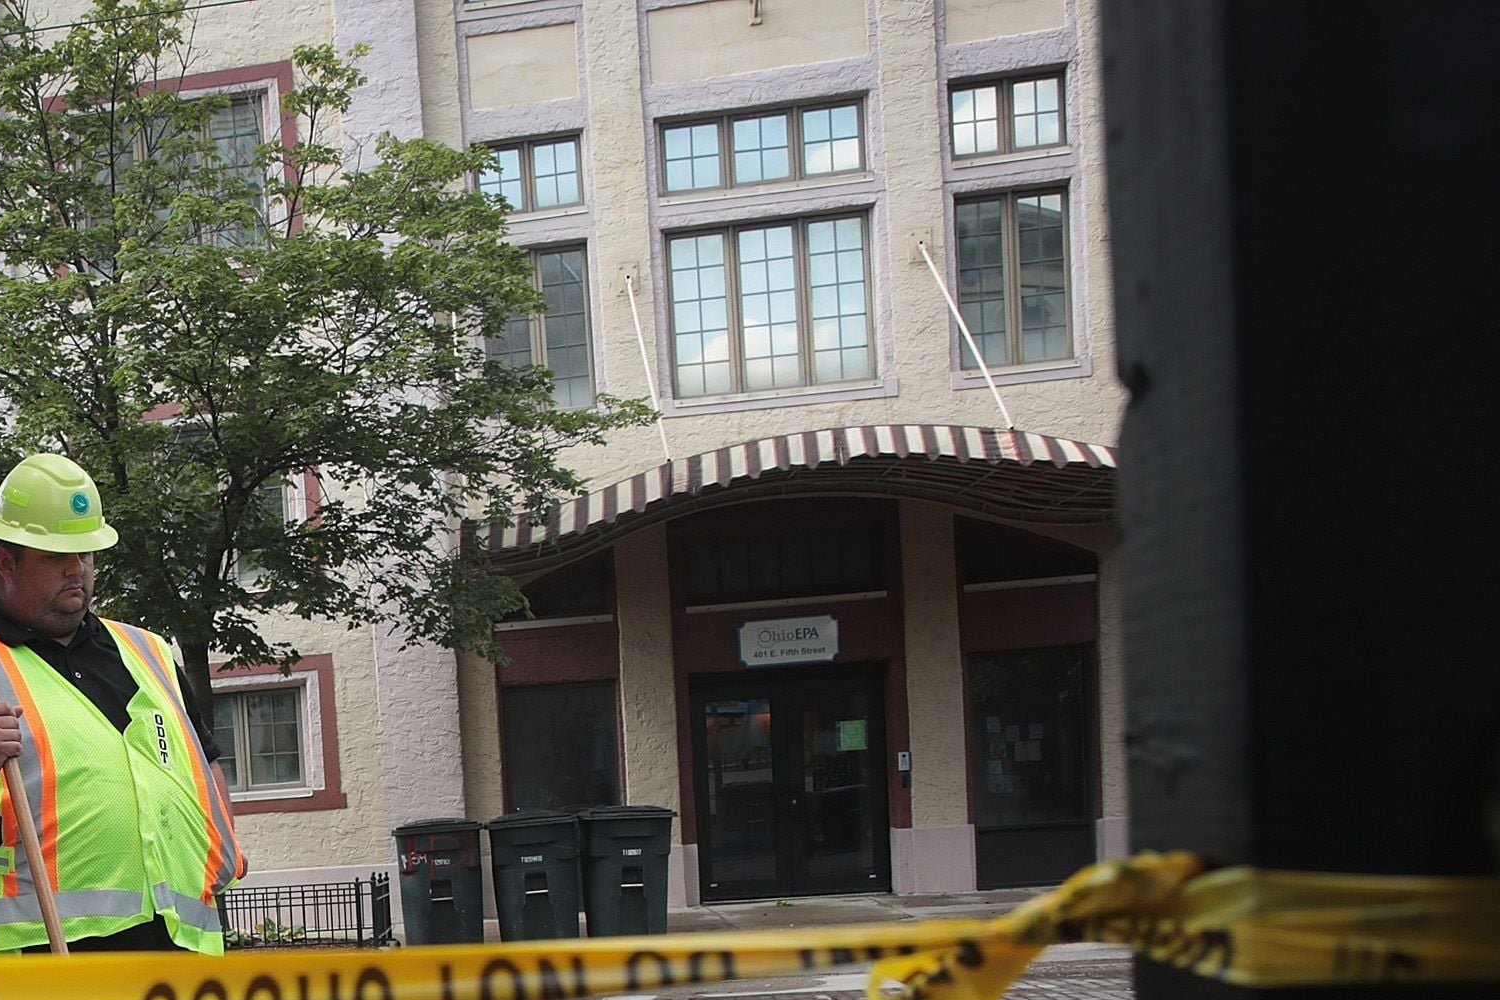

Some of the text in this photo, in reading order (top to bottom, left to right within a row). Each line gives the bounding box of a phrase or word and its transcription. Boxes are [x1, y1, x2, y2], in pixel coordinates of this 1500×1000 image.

[754, 646, 826, 659] 401 E. Fifth Street
[155, 714, 168, 763] ODOT
